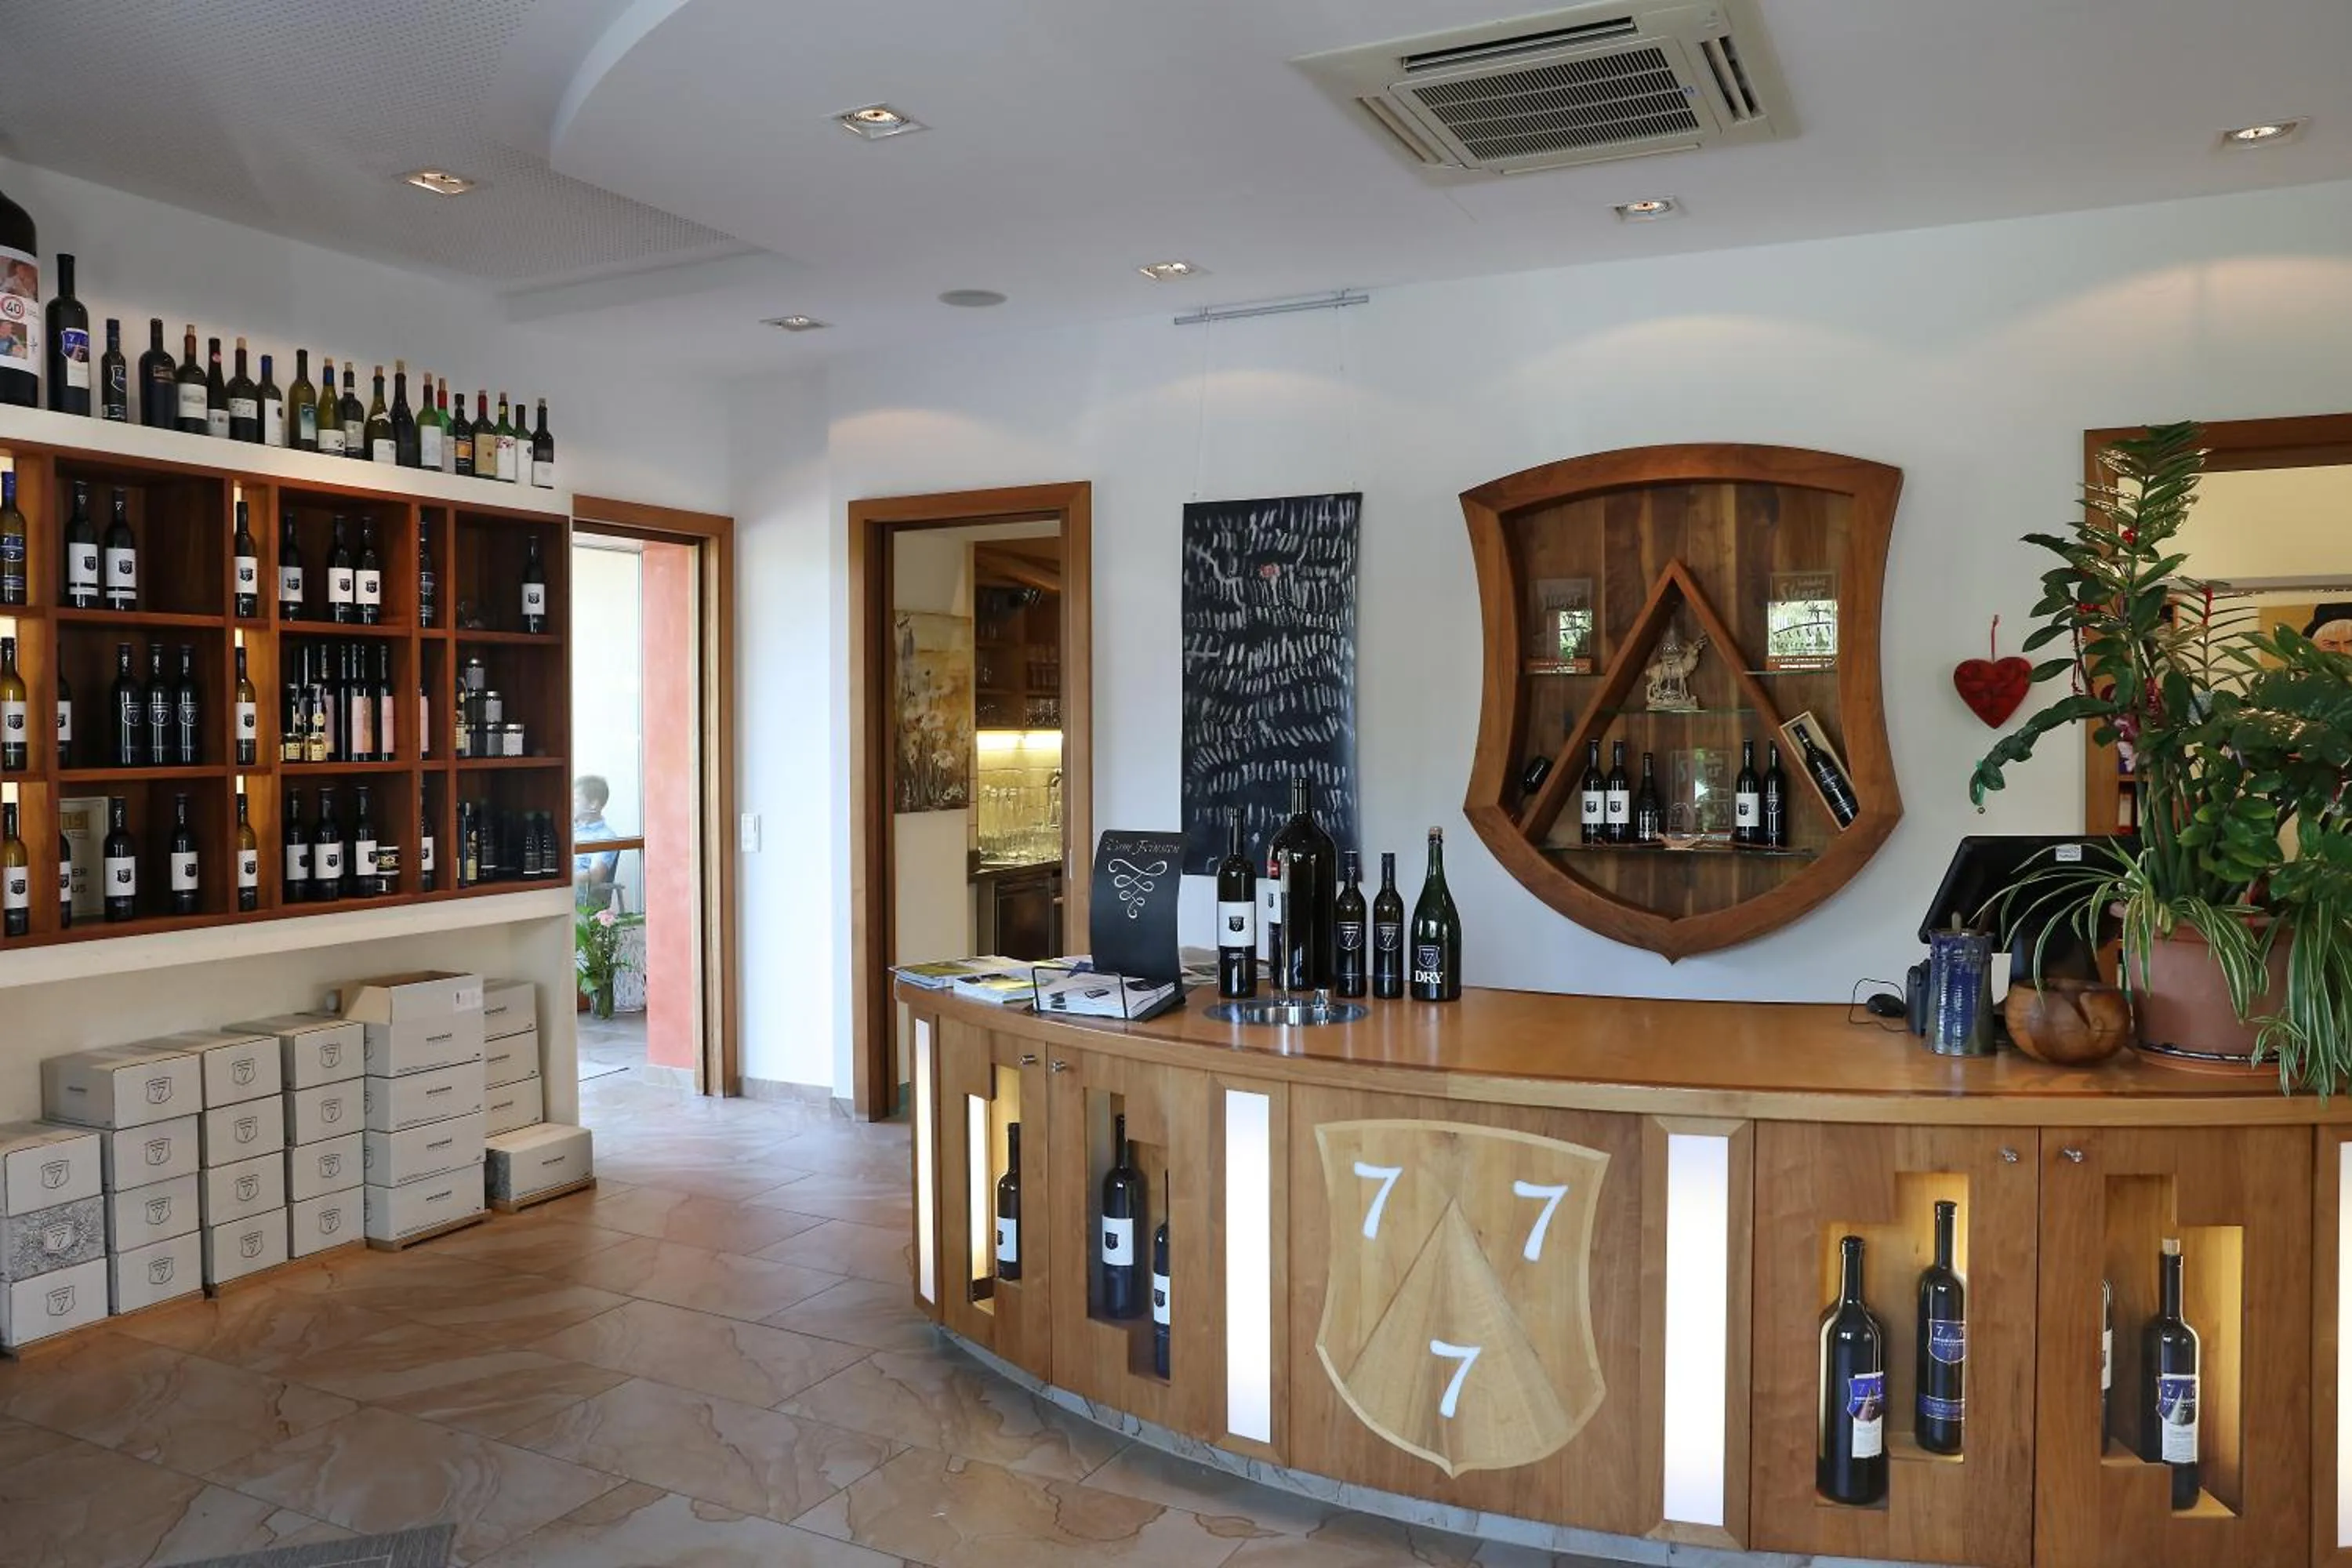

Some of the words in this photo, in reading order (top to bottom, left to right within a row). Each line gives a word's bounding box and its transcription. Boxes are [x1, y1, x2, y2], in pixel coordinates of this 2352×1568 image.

[5, 301, 22, 316] 40
[72, 868, 87, 877] ER
[71, 884, 87, 894] US
[1415, 970, 1443, 984] DRY
[1353, 1161, 1403, 1240] 7
[1513, 1180, 1569, 1262] 7
[1936, 1326, 1944, 1336] 7
[1429, 1339, 1481, 1418] 7
